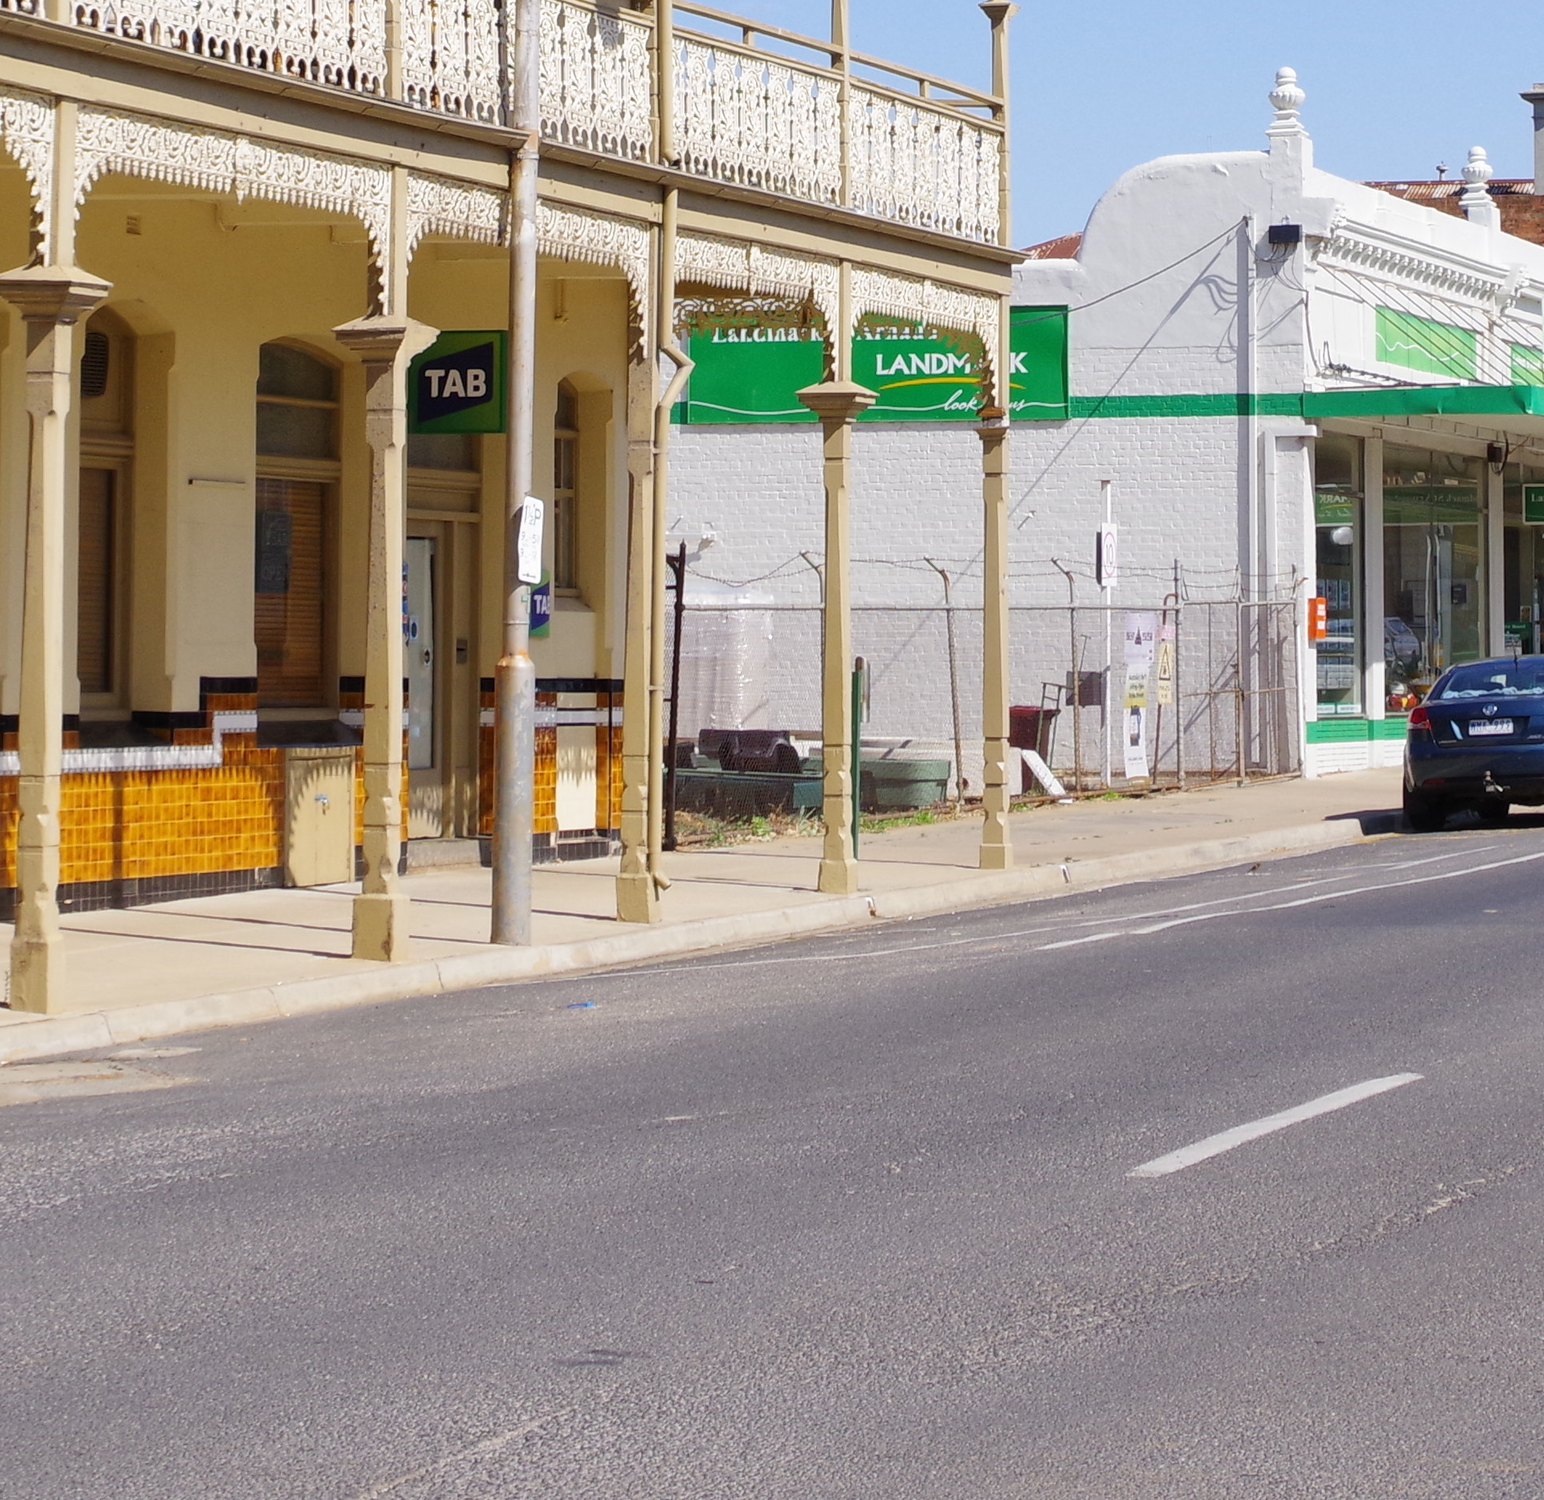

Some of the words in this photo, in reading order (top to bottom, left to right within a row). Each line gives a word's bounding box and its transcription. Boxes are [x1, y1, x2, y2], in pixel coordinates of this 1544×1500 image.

[875, 351, 1029, 376] LANDMK
[424, 368, 488, 399] TAB
[1105, 543, 1114, 565] 10
